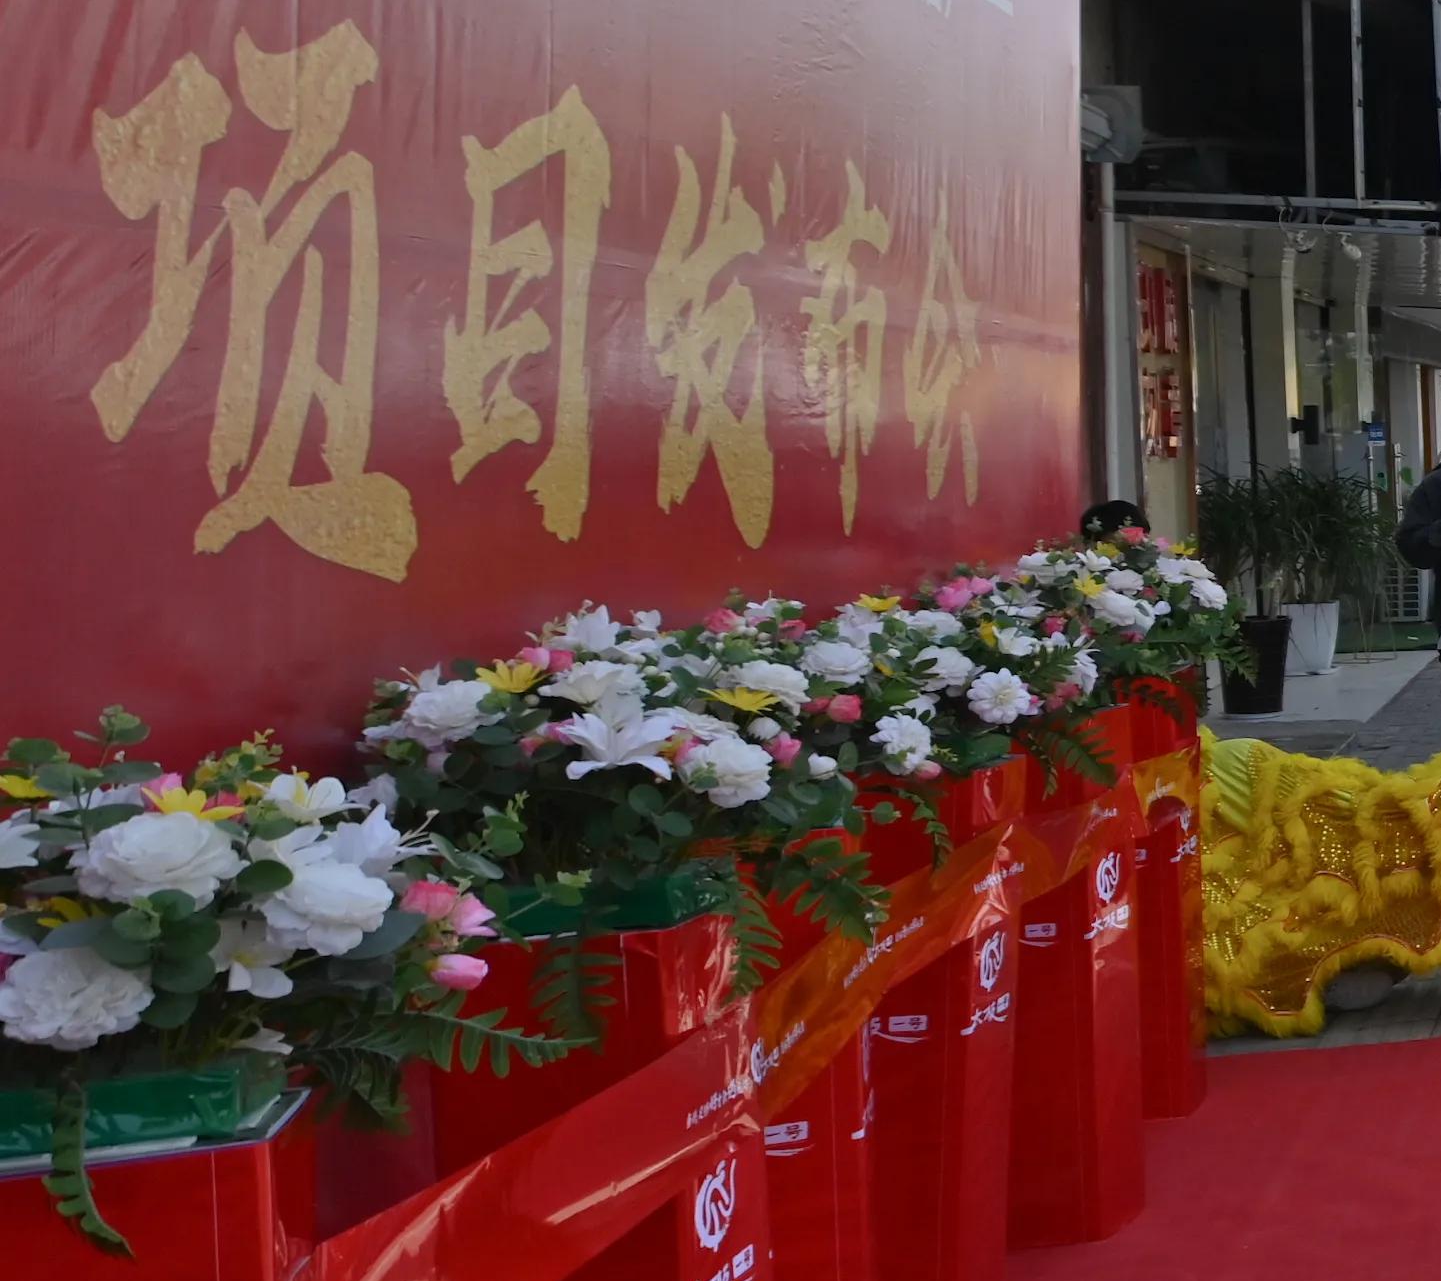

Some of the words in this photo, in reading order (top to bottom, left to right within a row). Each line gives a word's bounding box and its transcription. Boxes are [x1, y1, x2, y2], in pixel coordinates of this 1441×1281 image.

[90, 18, 981, 583] 项目发布会
